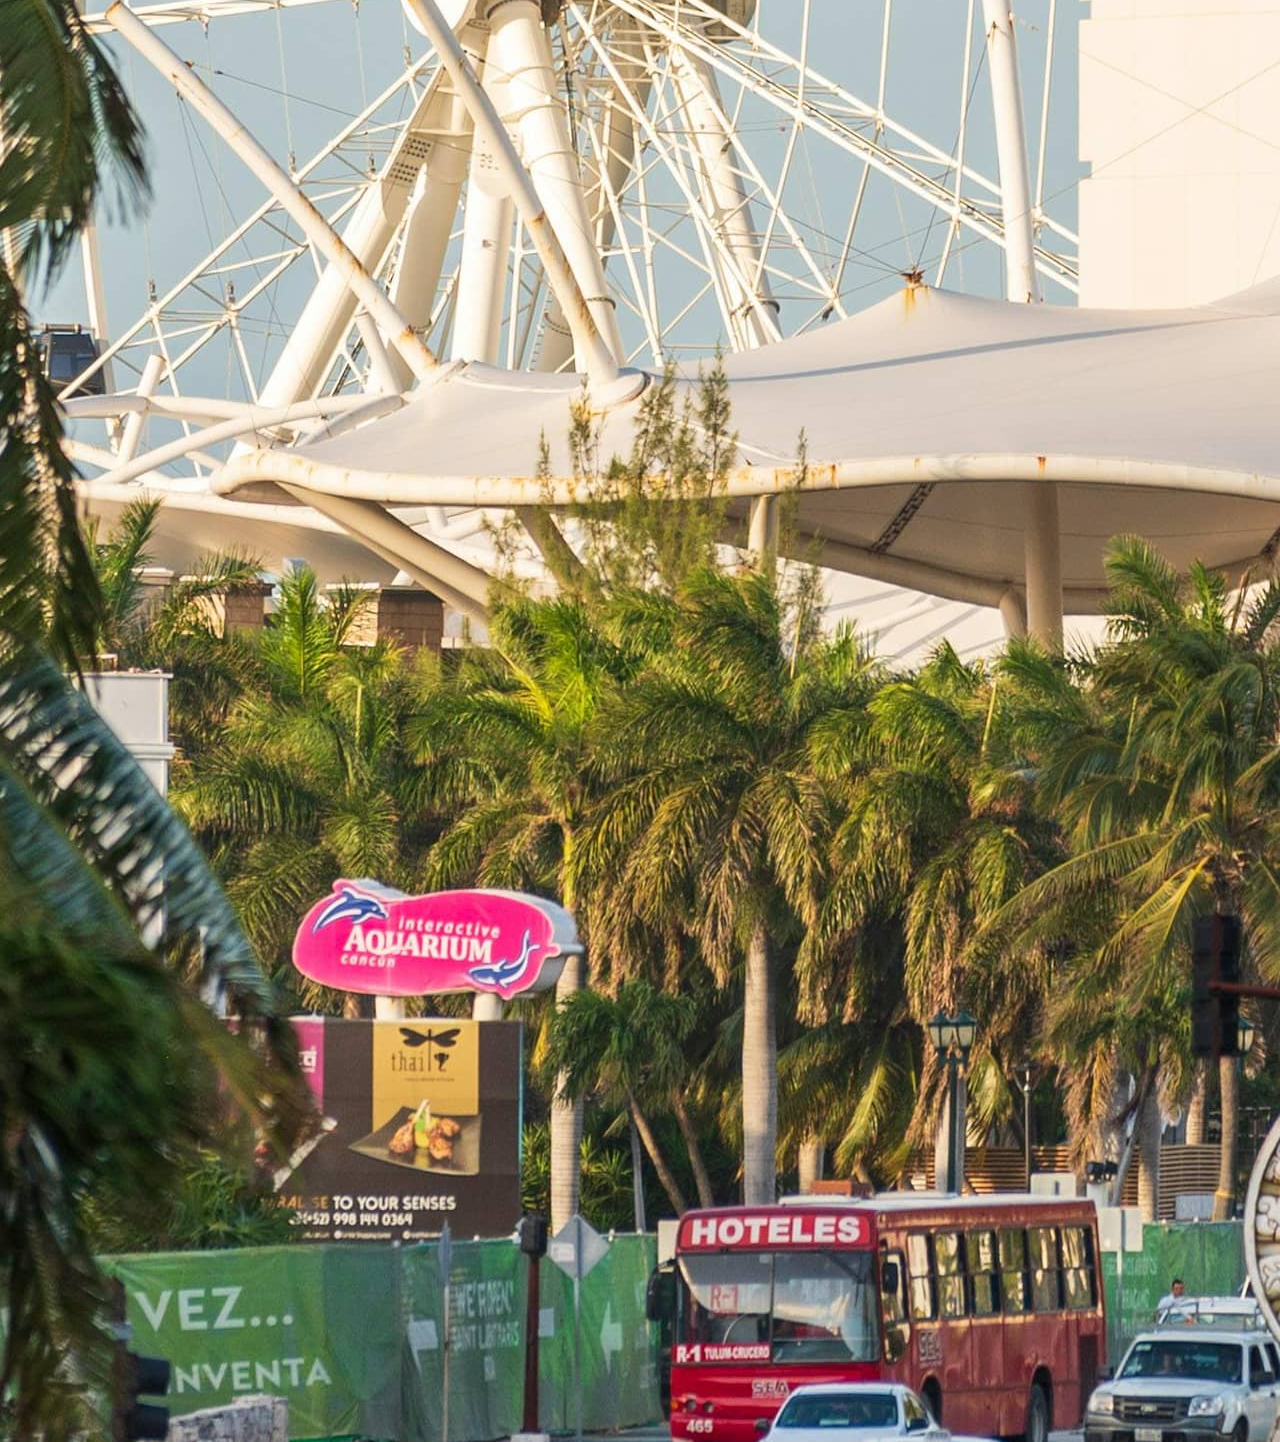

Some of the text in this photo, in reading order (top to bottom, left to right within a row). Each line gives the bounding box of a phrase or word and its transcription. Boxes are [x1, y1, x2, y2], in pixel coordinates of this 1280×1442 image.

[398, 916, 501, 939] interactive
[343, 925, 493, 964] AQUARIUM
[332, 1195, 354, 1210] TO
[357, 1195, 398, 1210] YOUR
[402, 1195, 456, 1211] SENSES
[333, 1212, 357, 1226] 998
[359, 1212, 379, 1226] 144
[382, 1212, 413, 1226] 0364
[691, 1217, 861, 1246] HOTELES
[135, 1286, 293, 1331] VEZ...
[710, 1285, 738, 1312] R-1
[676, 1345, 701, 1363] R-1
